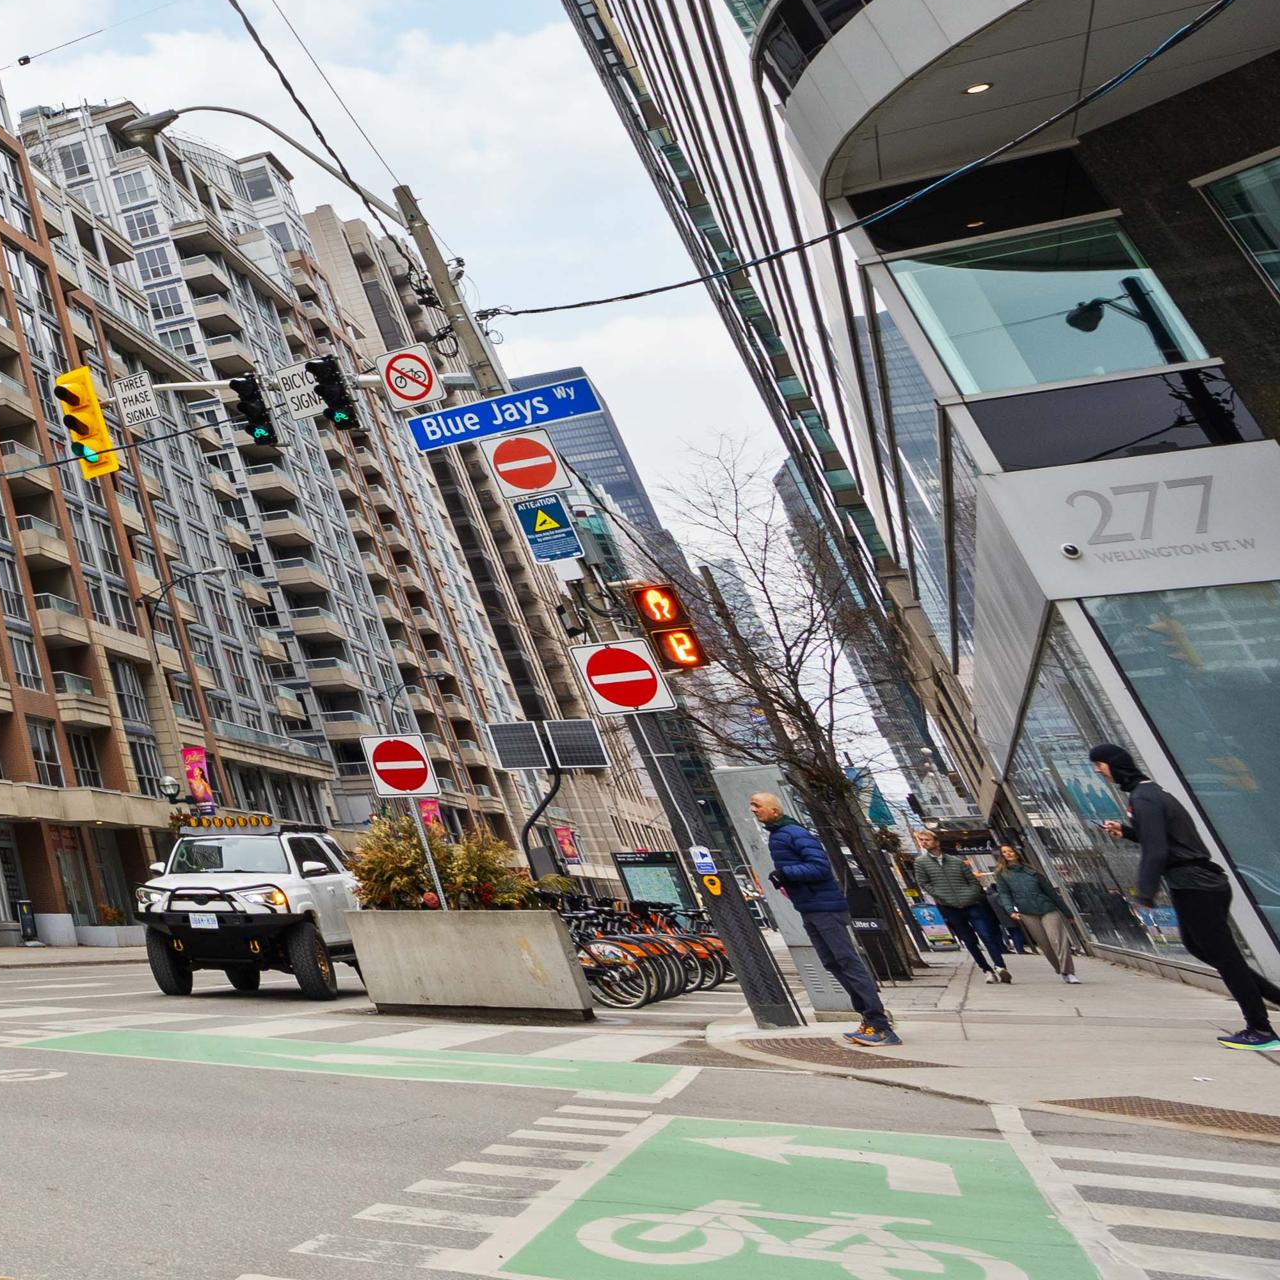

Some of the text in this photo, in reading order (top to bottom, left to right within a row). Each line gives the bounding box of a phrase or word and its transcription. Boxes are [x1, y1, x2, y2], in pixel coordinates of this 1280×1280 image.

[118, 375, 146, 393] THREE
[281, 371, 315, 392] BICYC
[122, 390, 151, 409] PHASE
[290, 391, 322, 411] SIGN
[126, 406, 157, 423] SIGNAL
[421, 386, 575, 441] Blue Jays Wy
[518, 496, 557, 511] ATTENTION
[1065, 474, 1214, 546] 277
[1094, 538, 1256, 564] WELLINGTON ST. W
[852, 920, 870, 928] Litter
